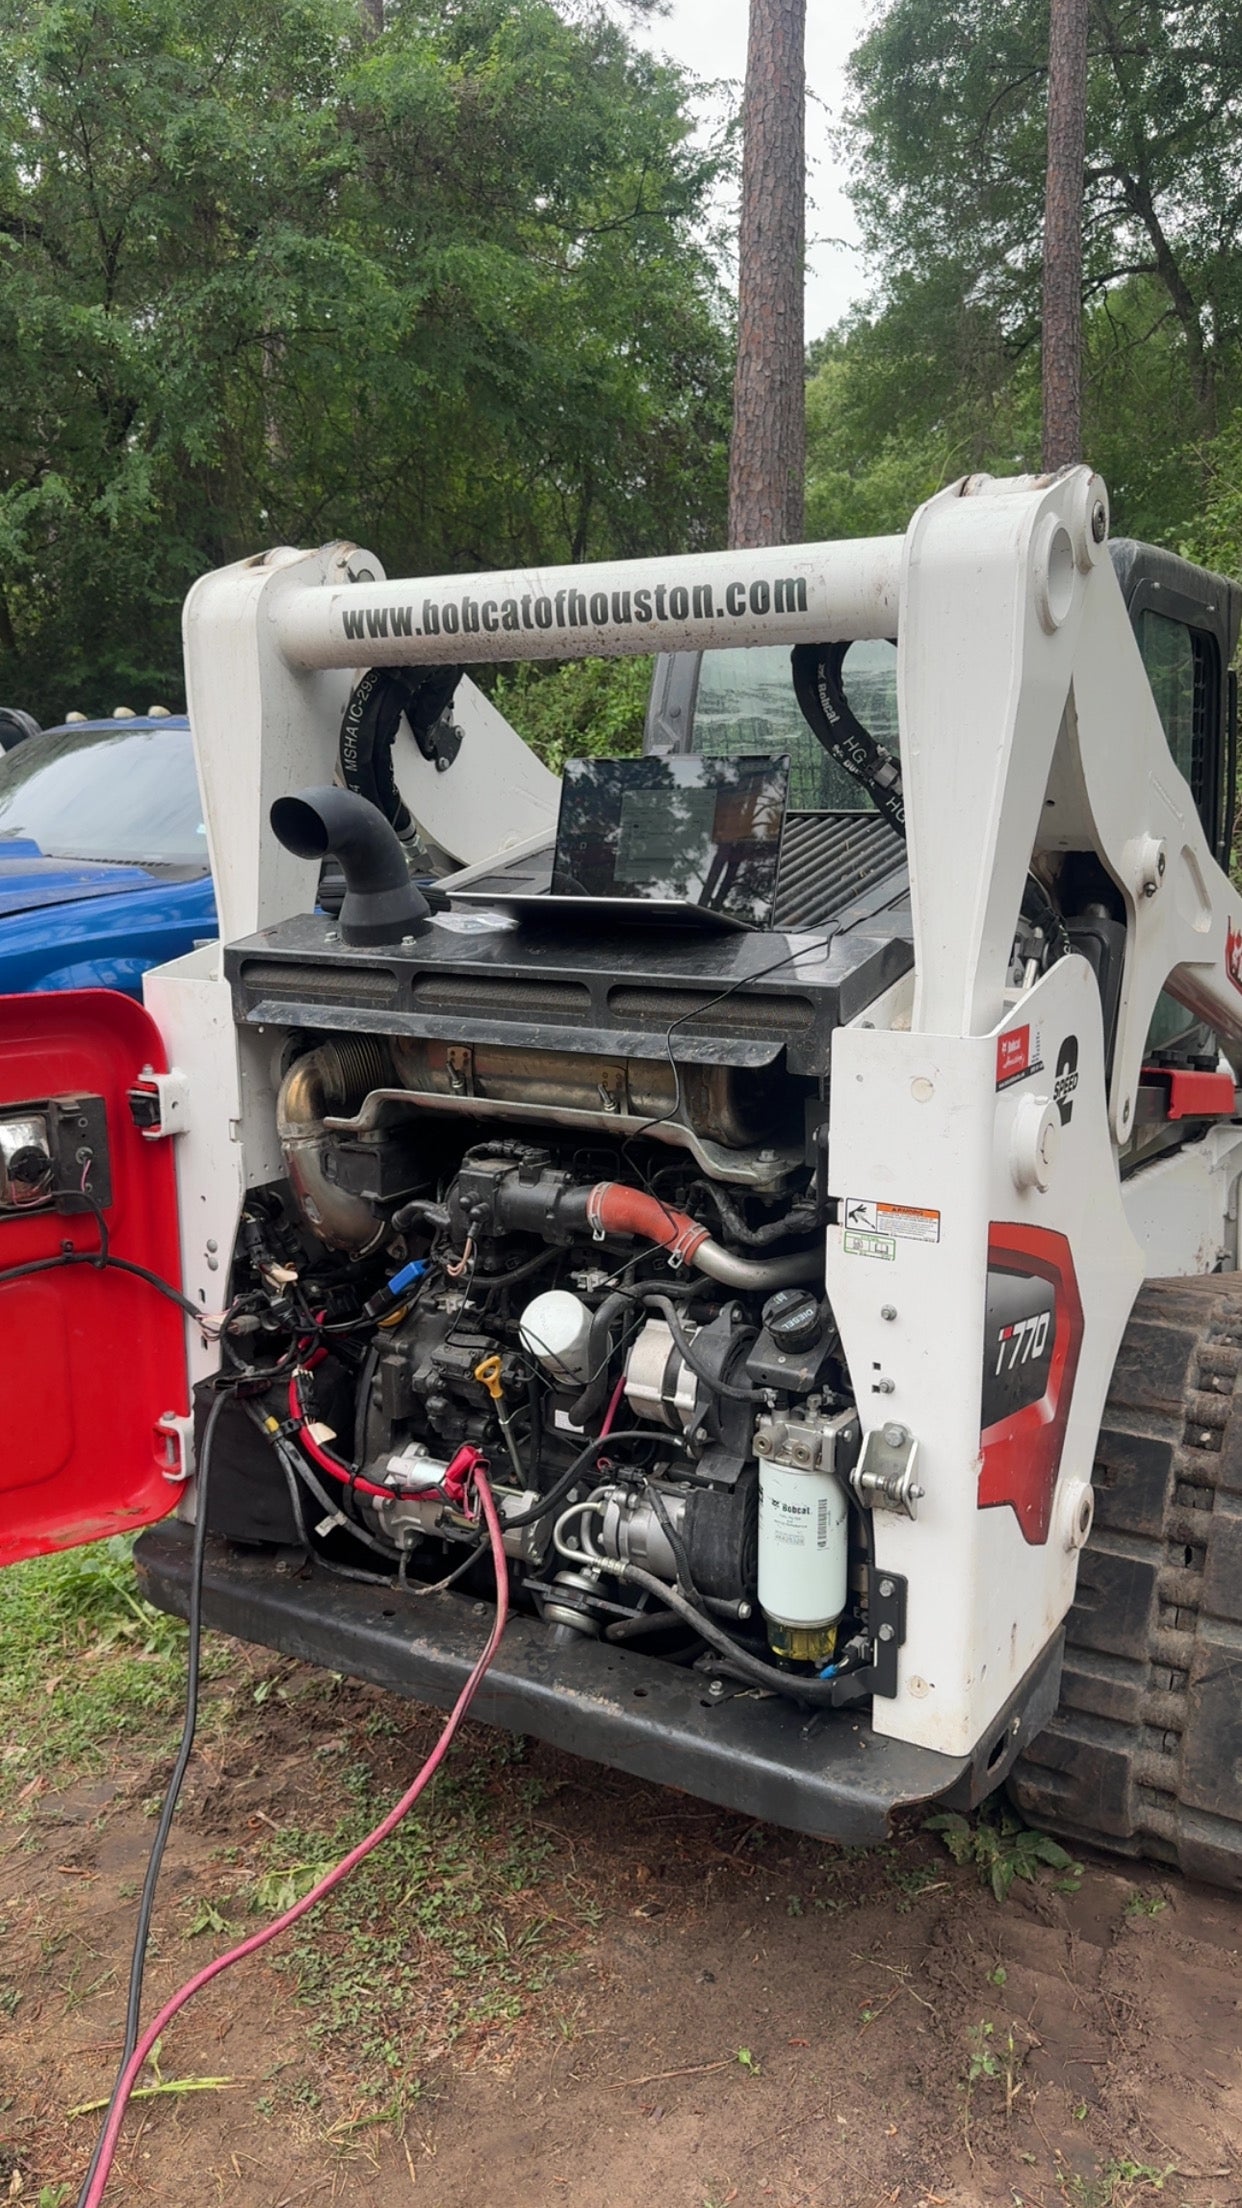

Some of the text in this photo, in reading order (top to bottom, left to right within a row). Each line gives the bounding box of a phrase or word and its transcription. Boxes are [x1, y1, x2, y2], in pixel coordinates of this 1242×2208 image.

[342, 577, 808, 640] www.bobcatofhouston.com
[343, 726, 359, 772] MSHA
[842, 735, 867, 764] HG
[1053, 1072, 1079, 1101] SPEED
[780, 1308, 814, 1329] DIESEL
[782, 1503, 811, 1515] Bobcat
